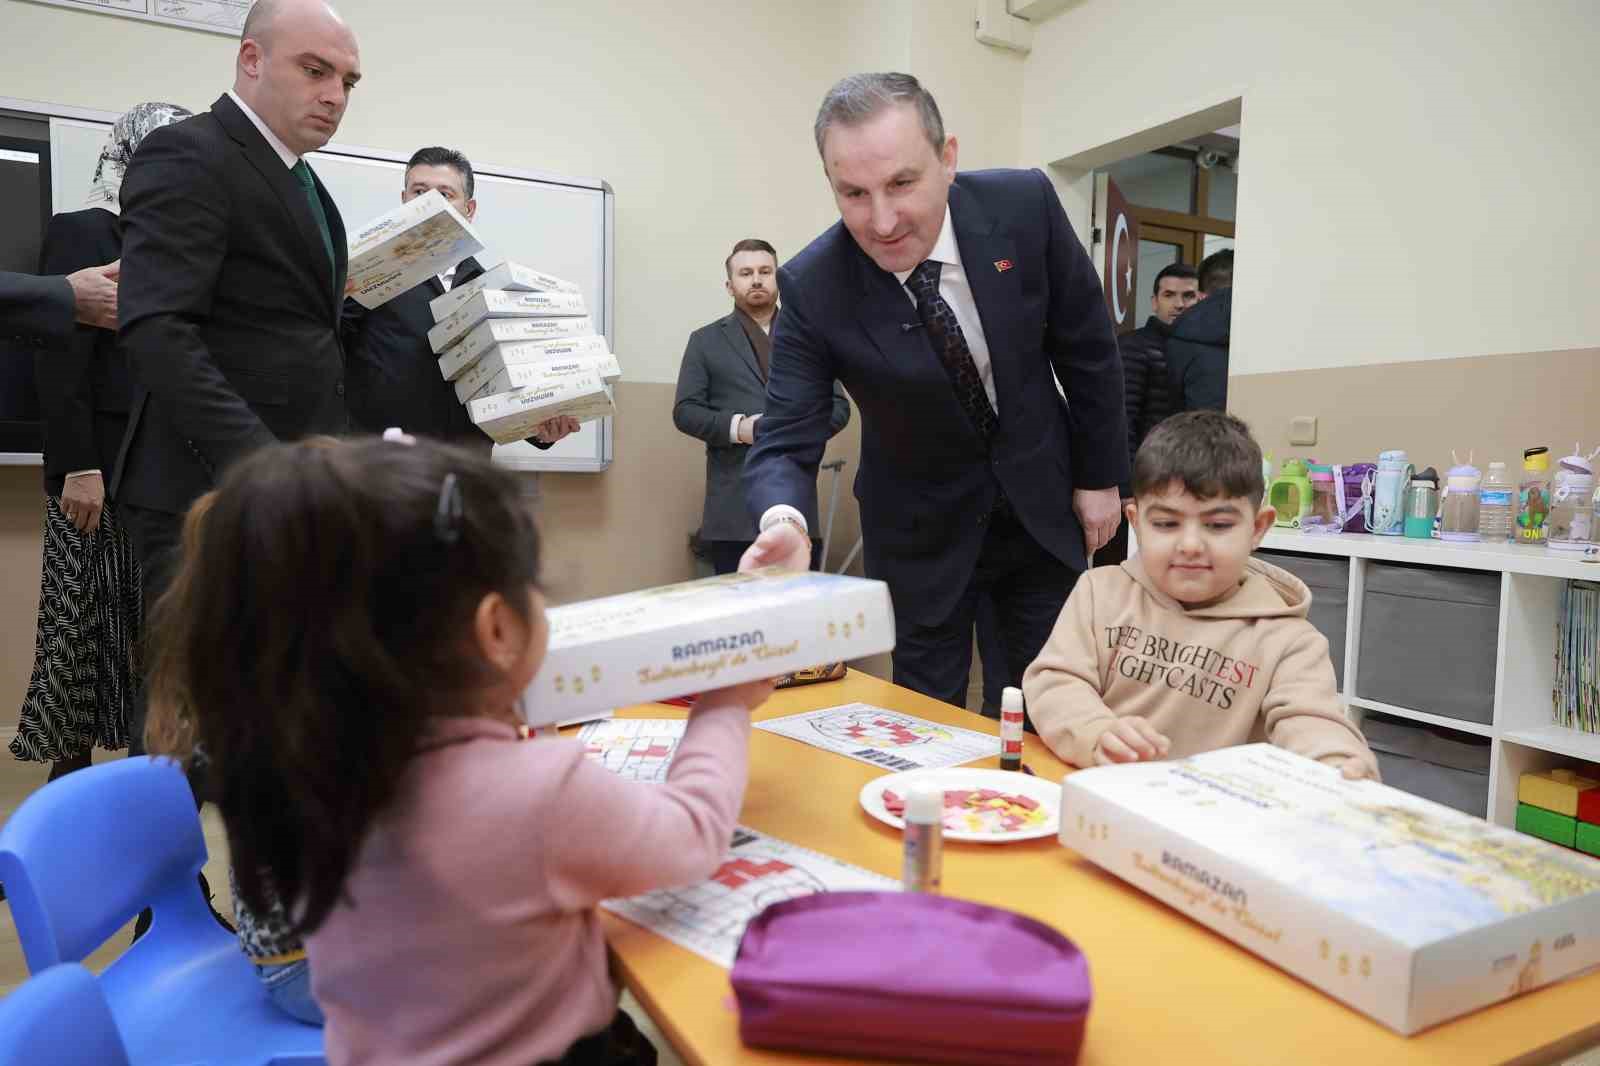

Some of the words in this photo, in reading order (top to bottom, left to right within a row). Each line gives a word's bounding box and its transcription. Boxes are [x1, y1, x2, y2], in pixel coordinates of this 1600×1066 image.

[671, 629, 766, 662] RAMAZAN
[1104, 625, 1143, 650] THE
[1142, 634, 1260, 689] BRIGHTEST
[1162, 848, 1248, 905] RAMAZAN
